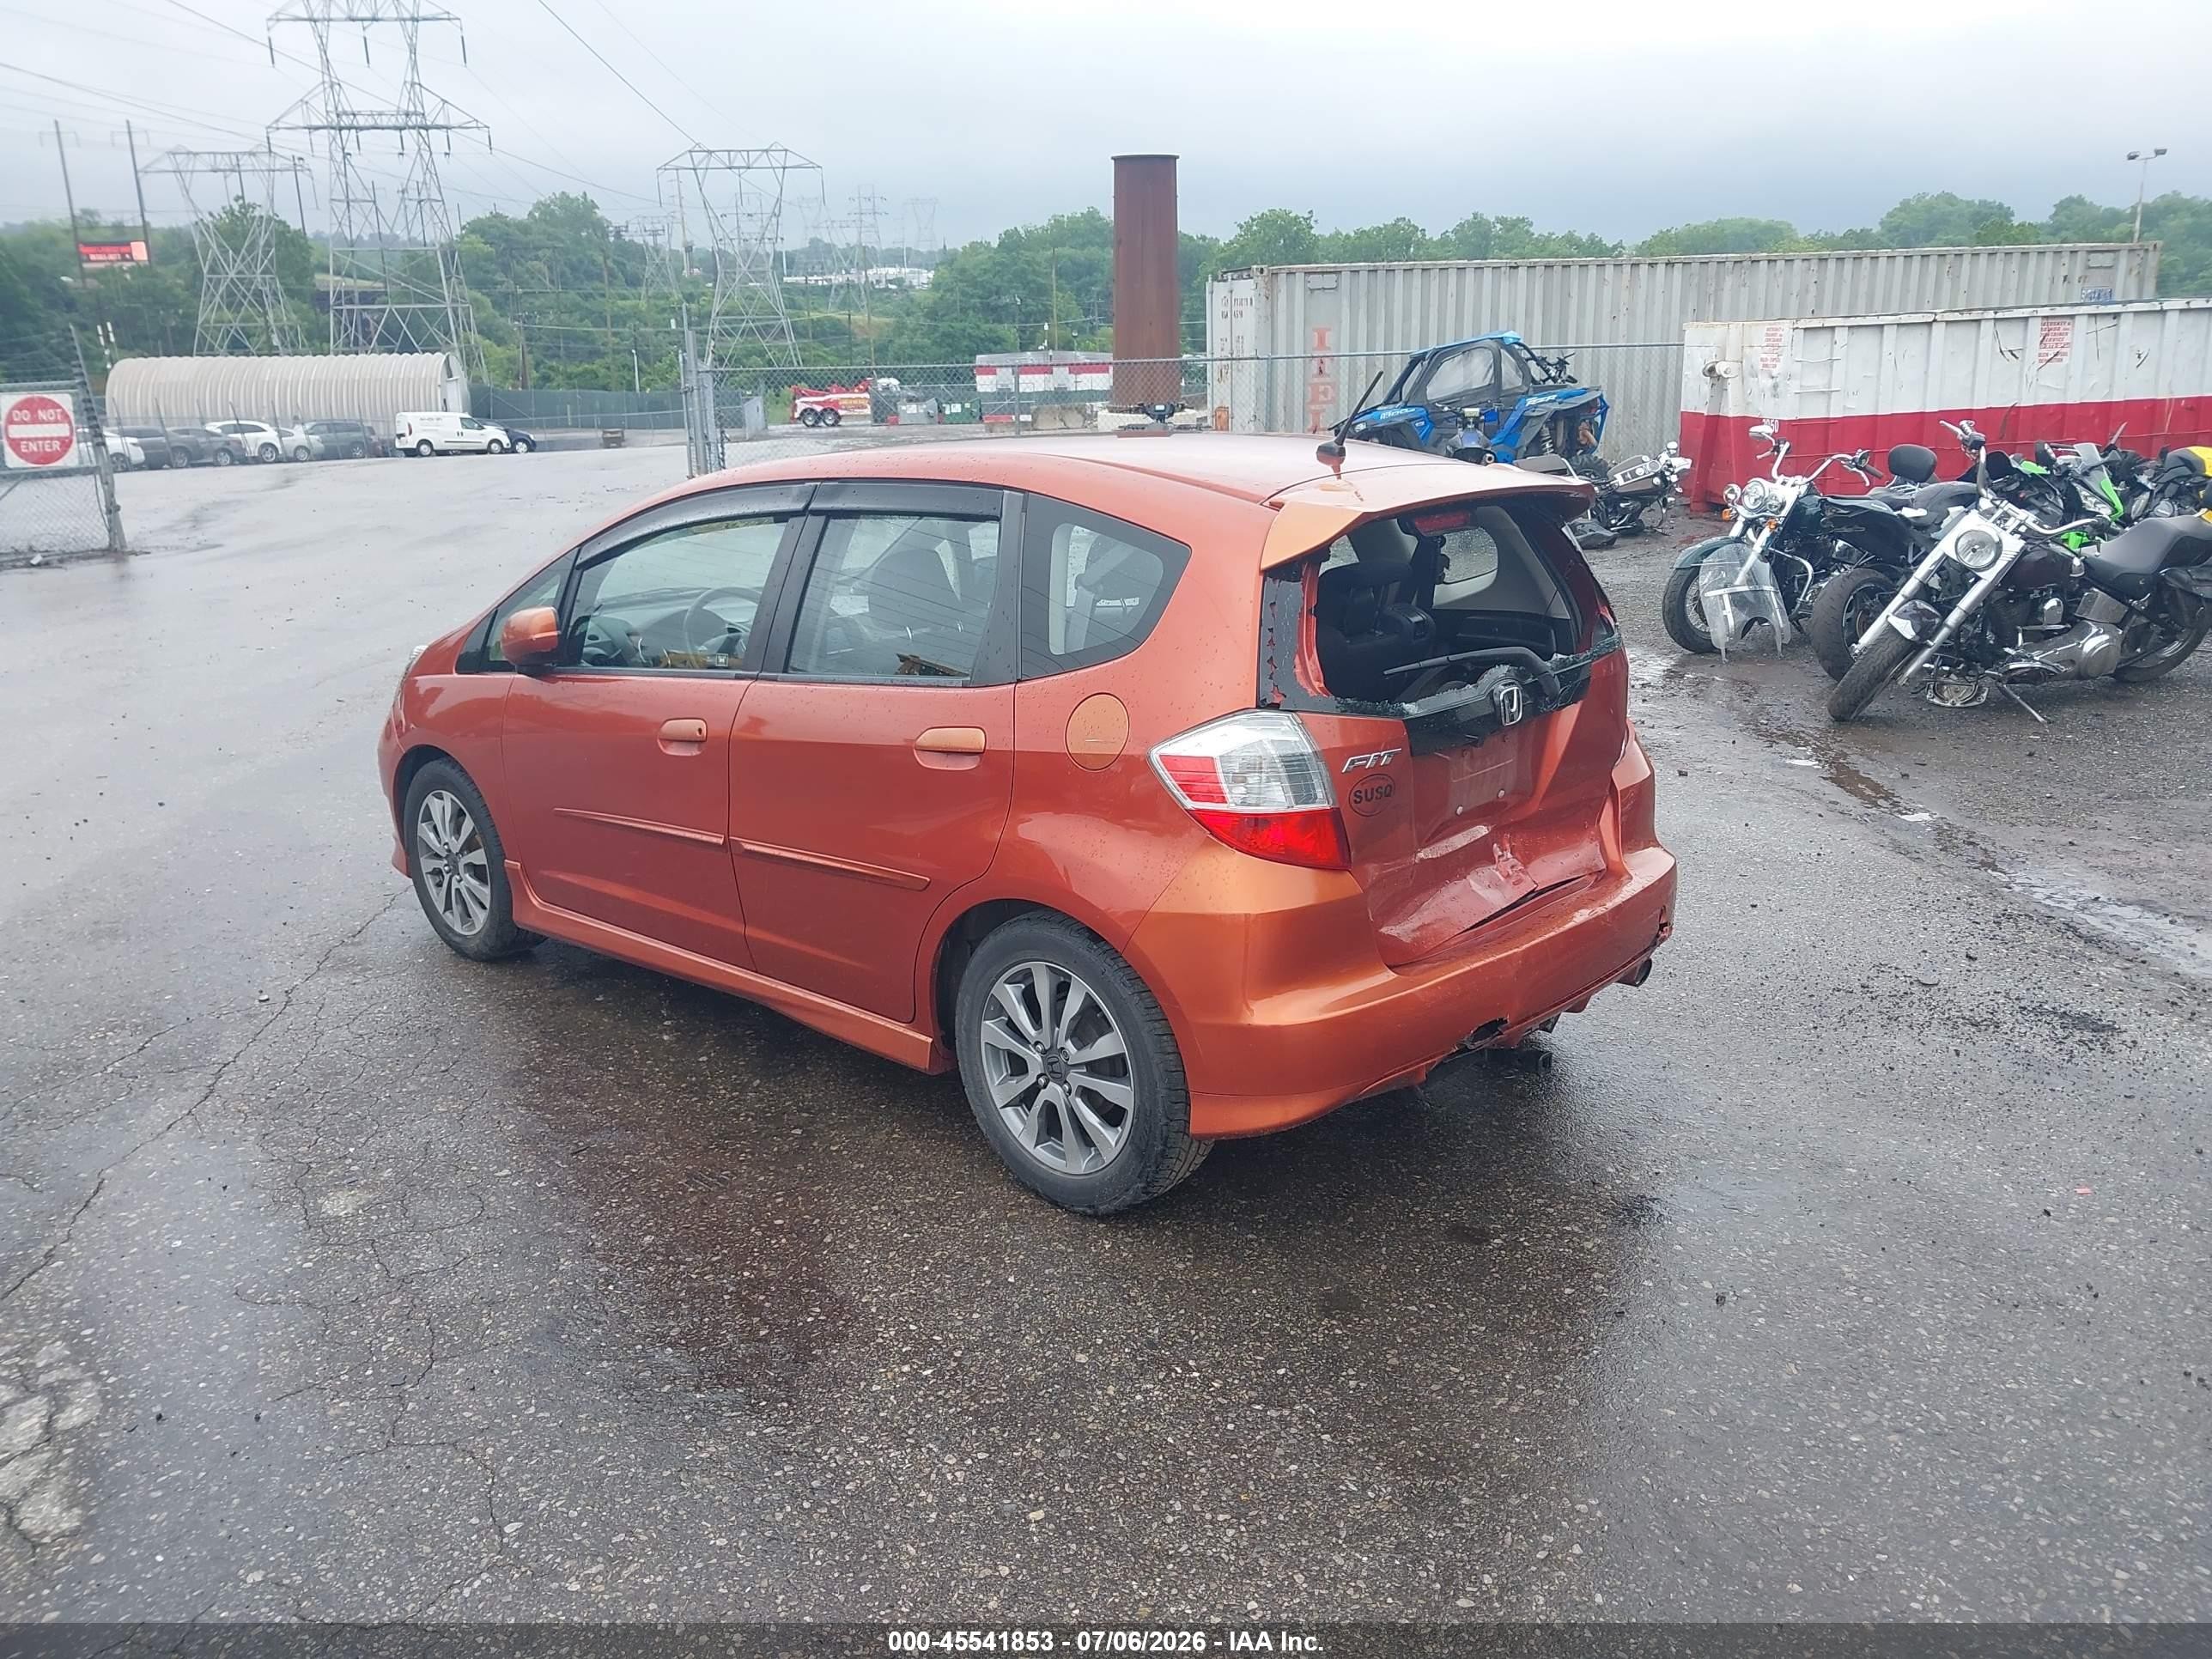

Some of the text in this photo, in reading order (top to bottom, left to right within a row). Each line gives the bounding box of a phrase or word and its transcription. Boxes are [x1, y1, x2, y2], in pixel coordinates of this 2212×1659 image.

[12, 408, 63, 422] DO NOT
[20, 439, 62, 453] ENTER
[1341, 748, 1402, 773] FIT
